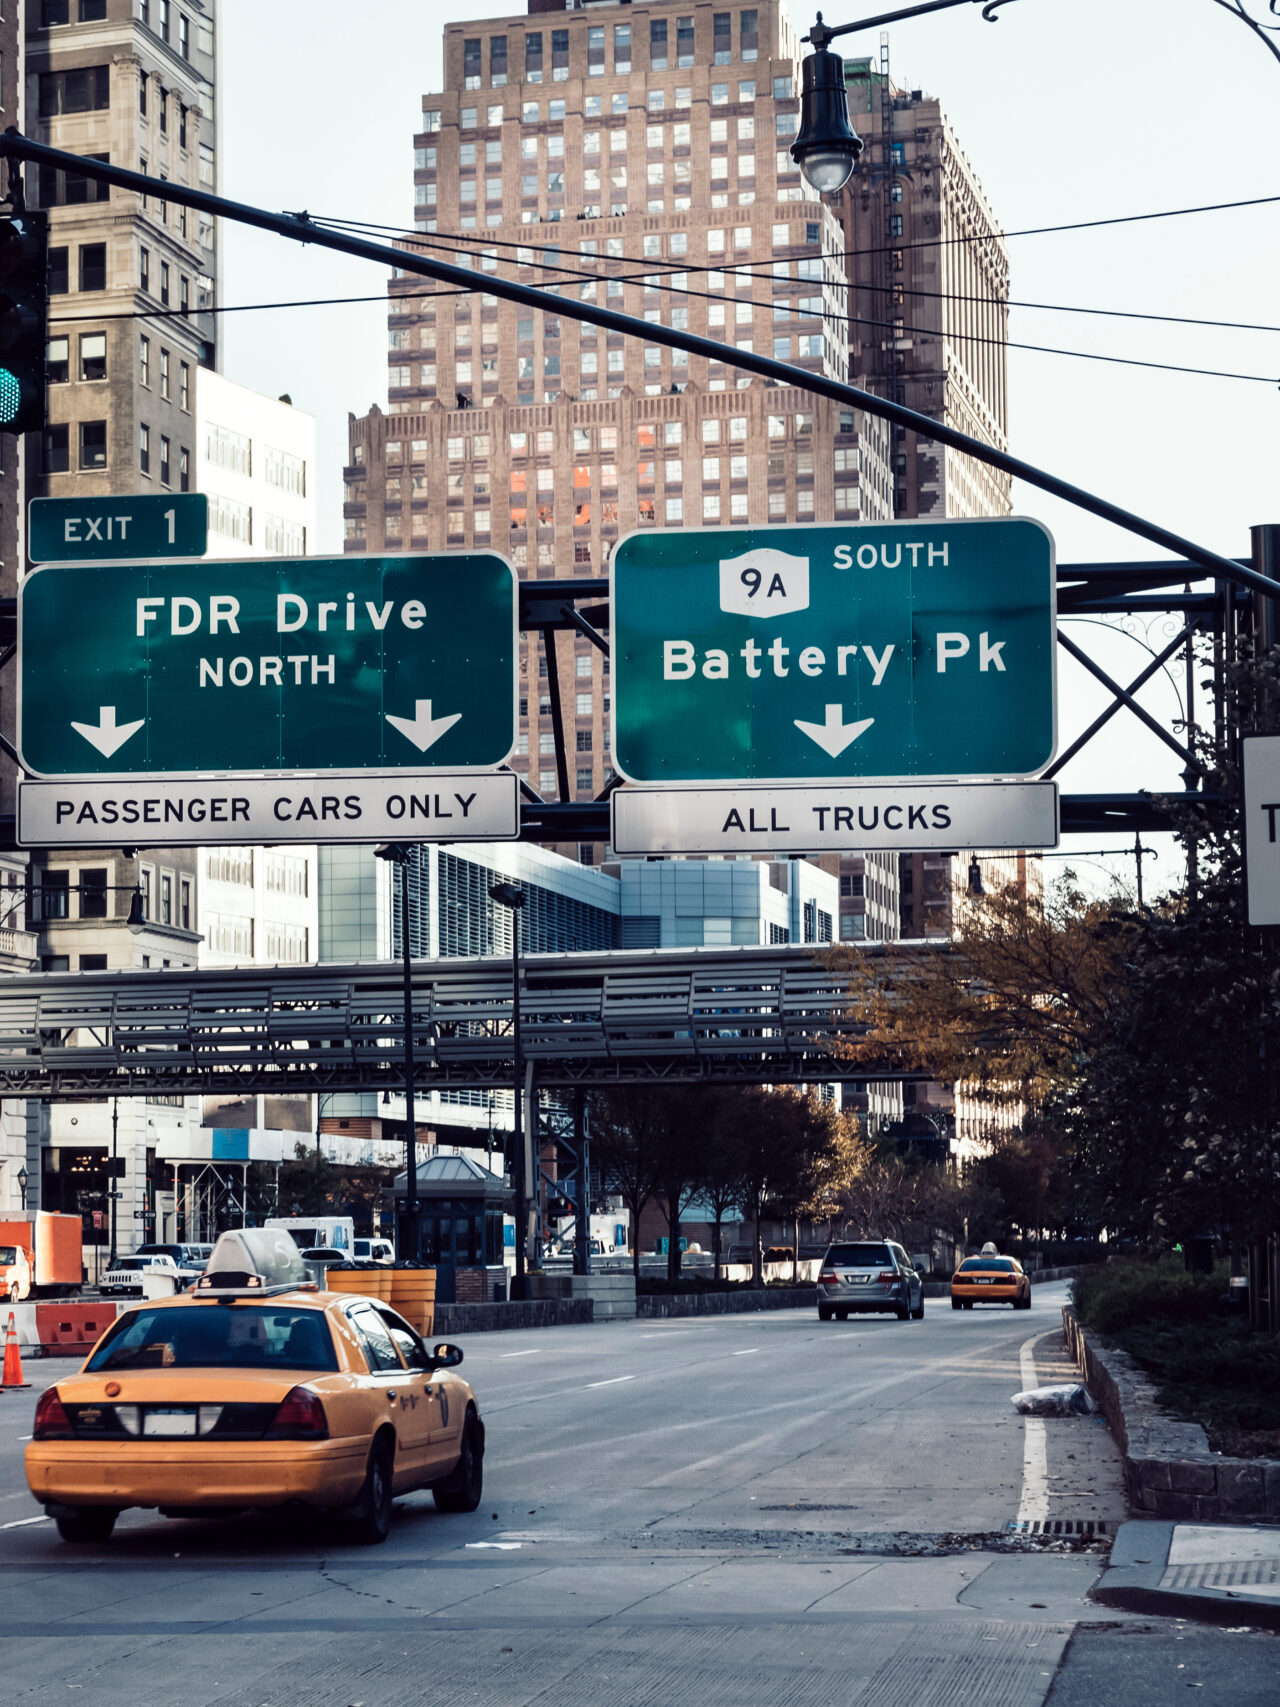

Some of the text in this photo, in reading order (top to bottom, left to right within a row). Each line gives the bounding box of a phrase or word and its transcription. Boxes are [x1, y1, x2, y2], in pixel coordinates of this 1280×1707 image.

[65, 509, 176, 544] EXIT 1
[833, 542, 948, 569] SOUTH
[741, 568, 786, 598] 9A
[137, 593, 426, 636] FDR Drive
[200, 655, 334, 687] NORTH
[664, 632, 1006, 685] Battery Pk
[57, 793, 476, 824] PASSENGER CARS ONLY
[722, 805, 951, 832] ALL TRUCKS
